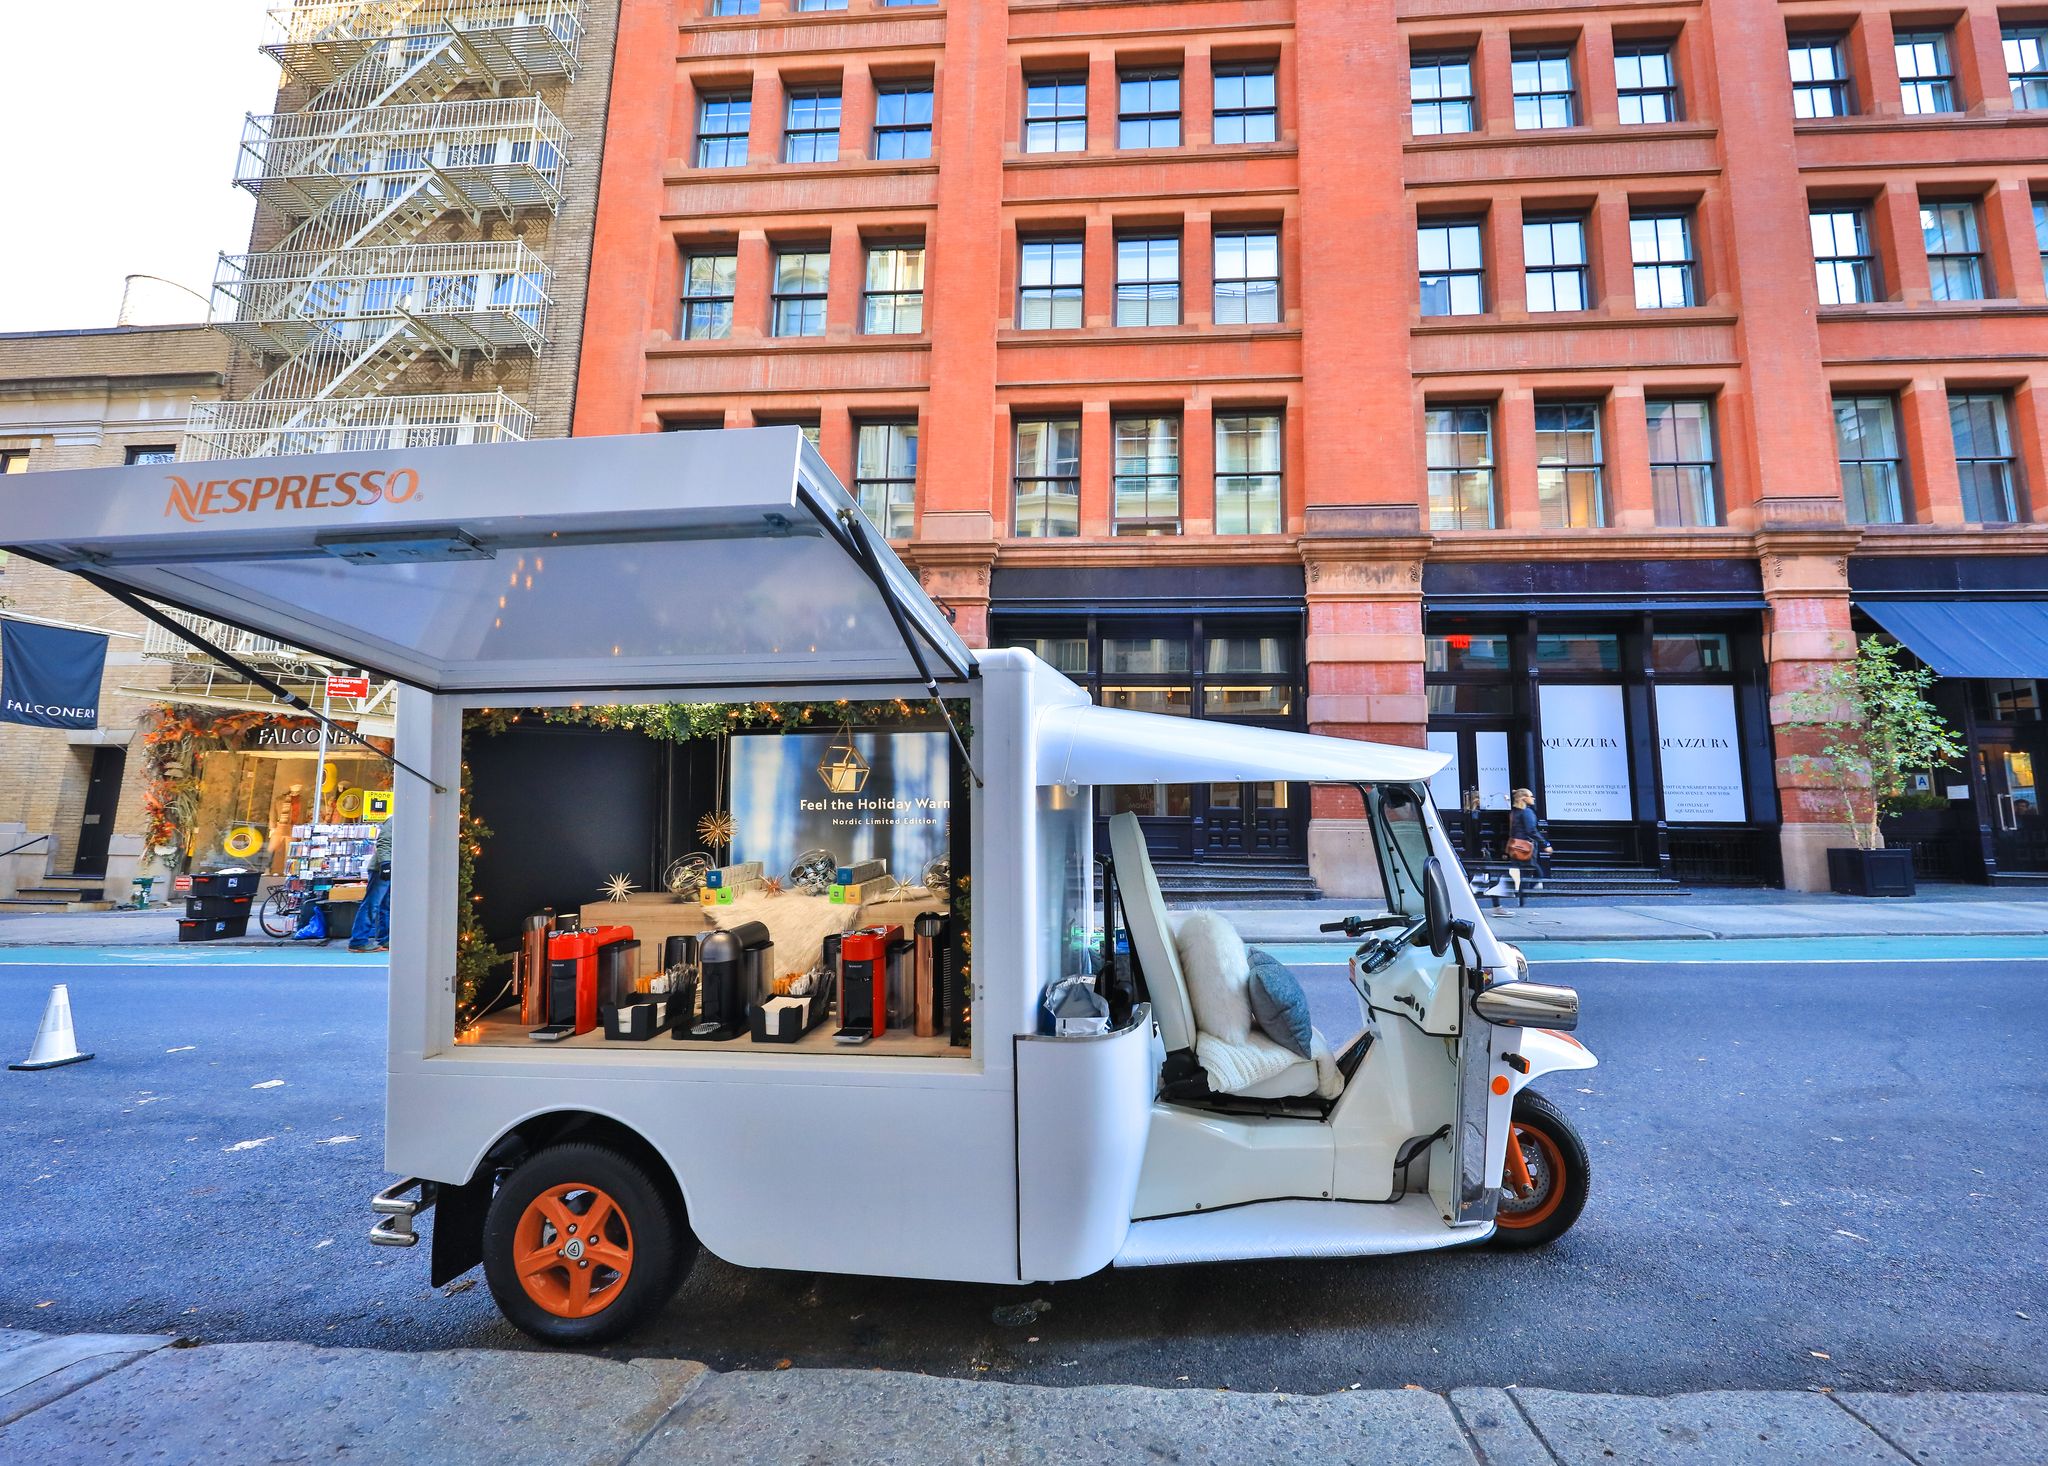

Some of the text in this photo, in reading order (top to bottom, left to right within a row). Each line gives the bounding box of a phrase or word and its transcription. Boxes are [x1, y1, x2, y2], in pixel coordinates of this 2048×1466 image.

[164, 468, 420, 523] NESPRESSO
[7, 699, 95, 718] FALCONERI
[1918, 777, 1927, 785] A
[800, 799, 827, 811] Feel
[831, 798, 854, 811] the
[858, 798, 911, 812] Holiday
